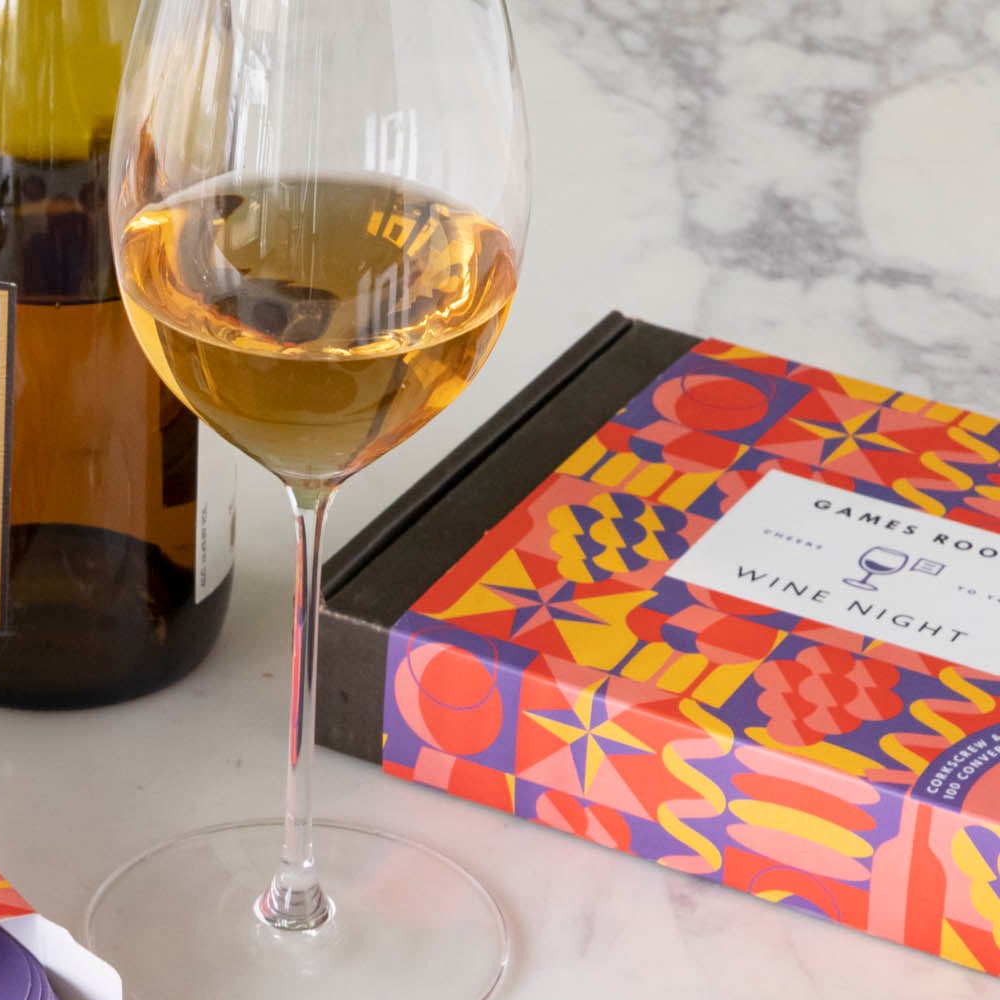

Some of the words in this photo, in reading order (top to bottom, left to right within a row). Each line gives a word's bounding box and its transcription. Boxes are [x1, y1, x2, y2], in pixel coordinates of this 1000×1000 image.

[813, 499, 919, 536] GAMES
[932, 533, 998, 558] ROO
[736, 565, 831, 603] WINE
[847, 600, 969, 643] NIGHT
[926, 739, 988, 795] CORKSCREW
[942, 782, 961, 800] 100
